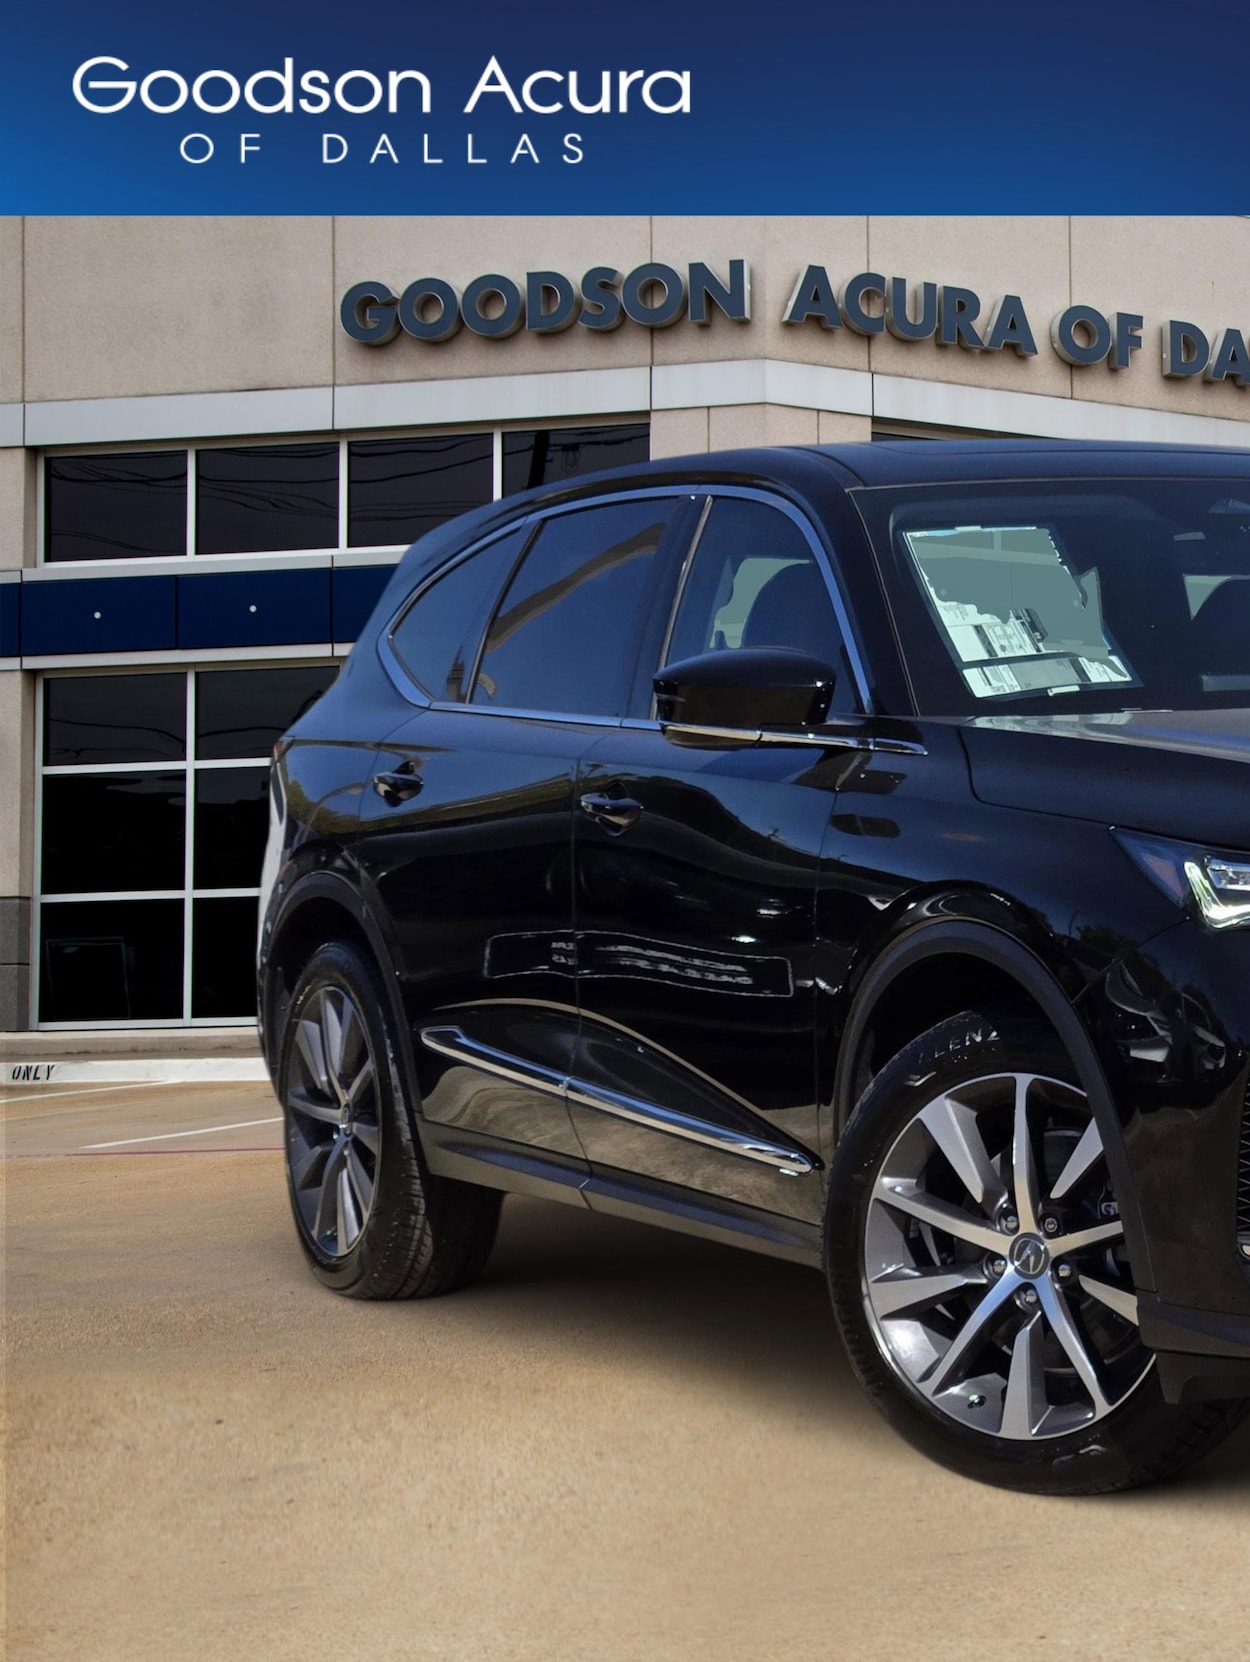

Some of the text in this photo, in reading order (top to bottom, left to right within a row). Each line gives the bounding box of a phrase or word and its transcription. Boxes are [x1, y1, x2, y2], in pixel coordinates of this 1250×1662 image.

[340, 259, 751, 345] GOODSON
[782, 264, 1038, 357] ACURA
[1051, 304, 1144, 369] OF
[12, 1064, 55, 1081] ONLY
